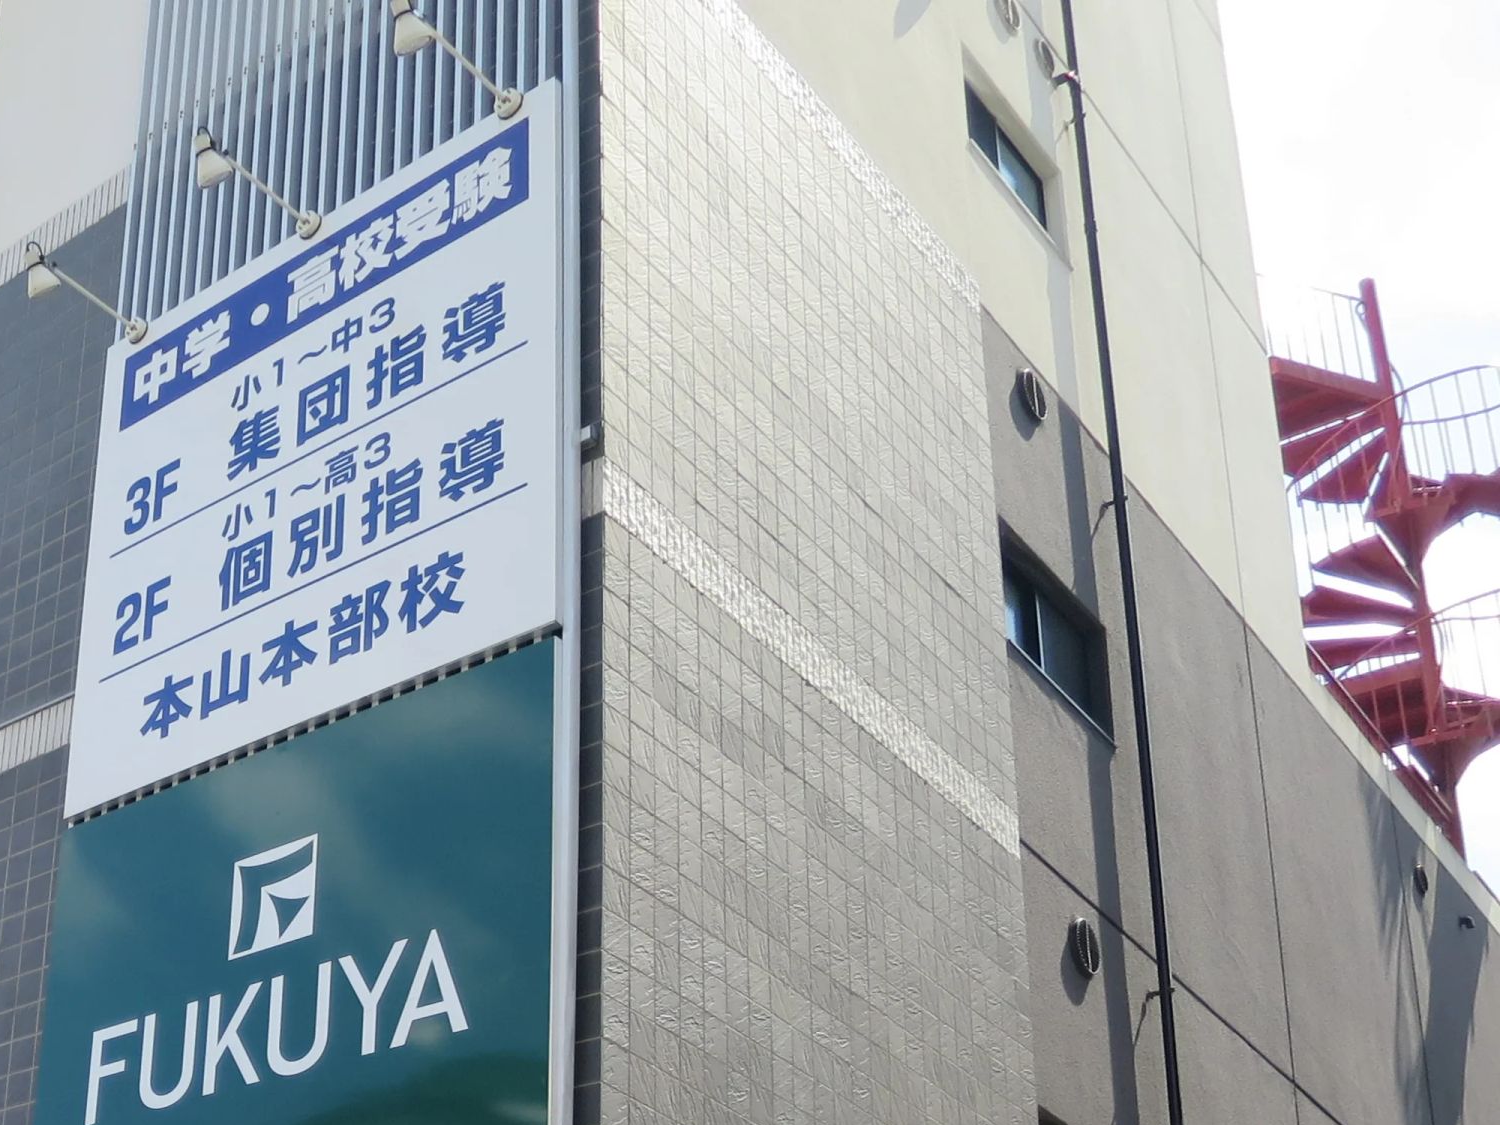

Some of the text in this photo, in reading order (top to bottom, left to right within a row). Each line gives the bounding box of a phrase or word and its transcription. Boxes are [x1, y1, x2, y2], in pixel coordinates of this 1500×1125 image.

[132, 147, 514, 404] 中学・高校受験
[123, 281, 507, 535] 3F 集団指導
[113, 418, 505, 655] 2F 個別指導
[140, 551, 467, 739] 本山本部校
[84, 929, 469, 1125] FUKUYA
